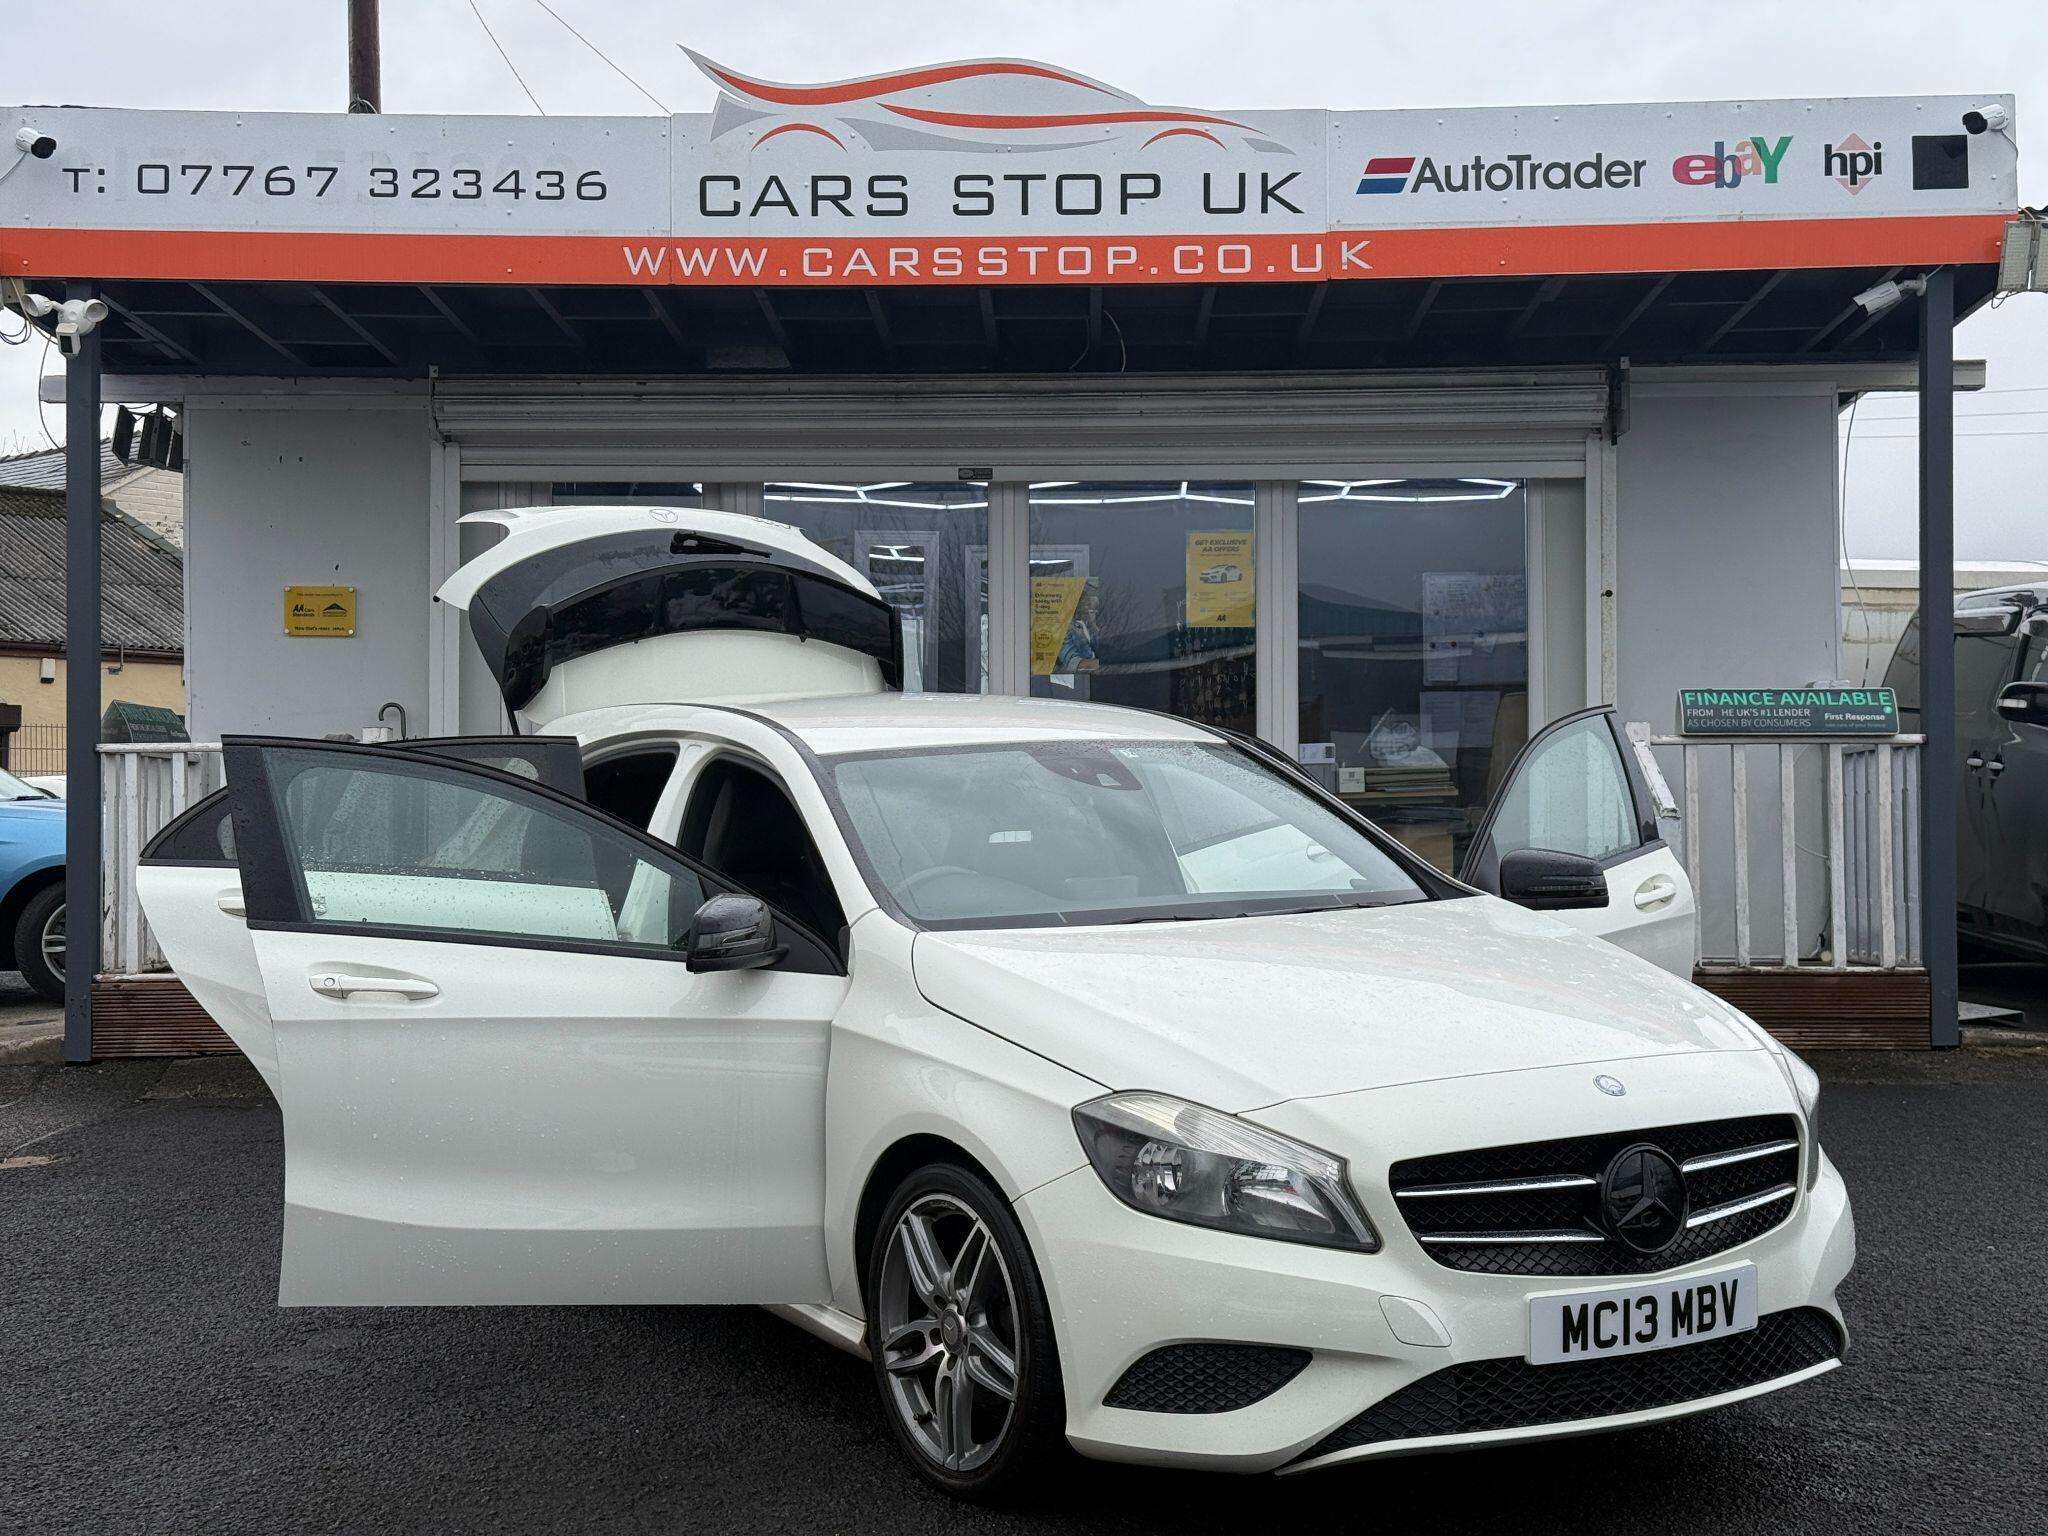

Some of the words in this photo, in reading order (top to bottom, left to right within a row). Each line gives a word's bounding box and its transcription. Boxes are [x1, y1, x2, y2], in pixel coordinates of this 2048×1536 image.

[1410, 152, 1647, 193] AutoTrader
[1824, 141, 1883, 186] hpi
[137, 164, 339, 197] 07767
[369, 168, 608, 201] 323436
[700, 174, 909, 217] CARS
[953, 172, 1162, 217] STOP
[1203, 171, 1305, 214] UK
[622, 240, 1374, 277] WWW.CARSSTOP.CO.UK
[293, 604, 304, 612] AA
[1216, 614, 1226, 622] AA
[1684, 692, 1776, 706] FINANCE
[1780, 692, 1892, 706] AVAILABLE
[1687, 708, 1714, 717] FROM
[1736, 708, 1759, 717] UK'S
[1773, 708, 1811, 717] LENDER
[1824, 713, 1843, 721] First
[1845, 713, 1886, 722] Response
[1687, 719, 1700, 728] AS
[1701, 719, 1739, 728] CHOSEN
[1741, 719, 1752, 728] BY
[1753, 718, 1812, 728] CONSUMERS
[1562, 1295, 1658, 1353] MC13
[1671, 1278, 1739, 1338] MBV
